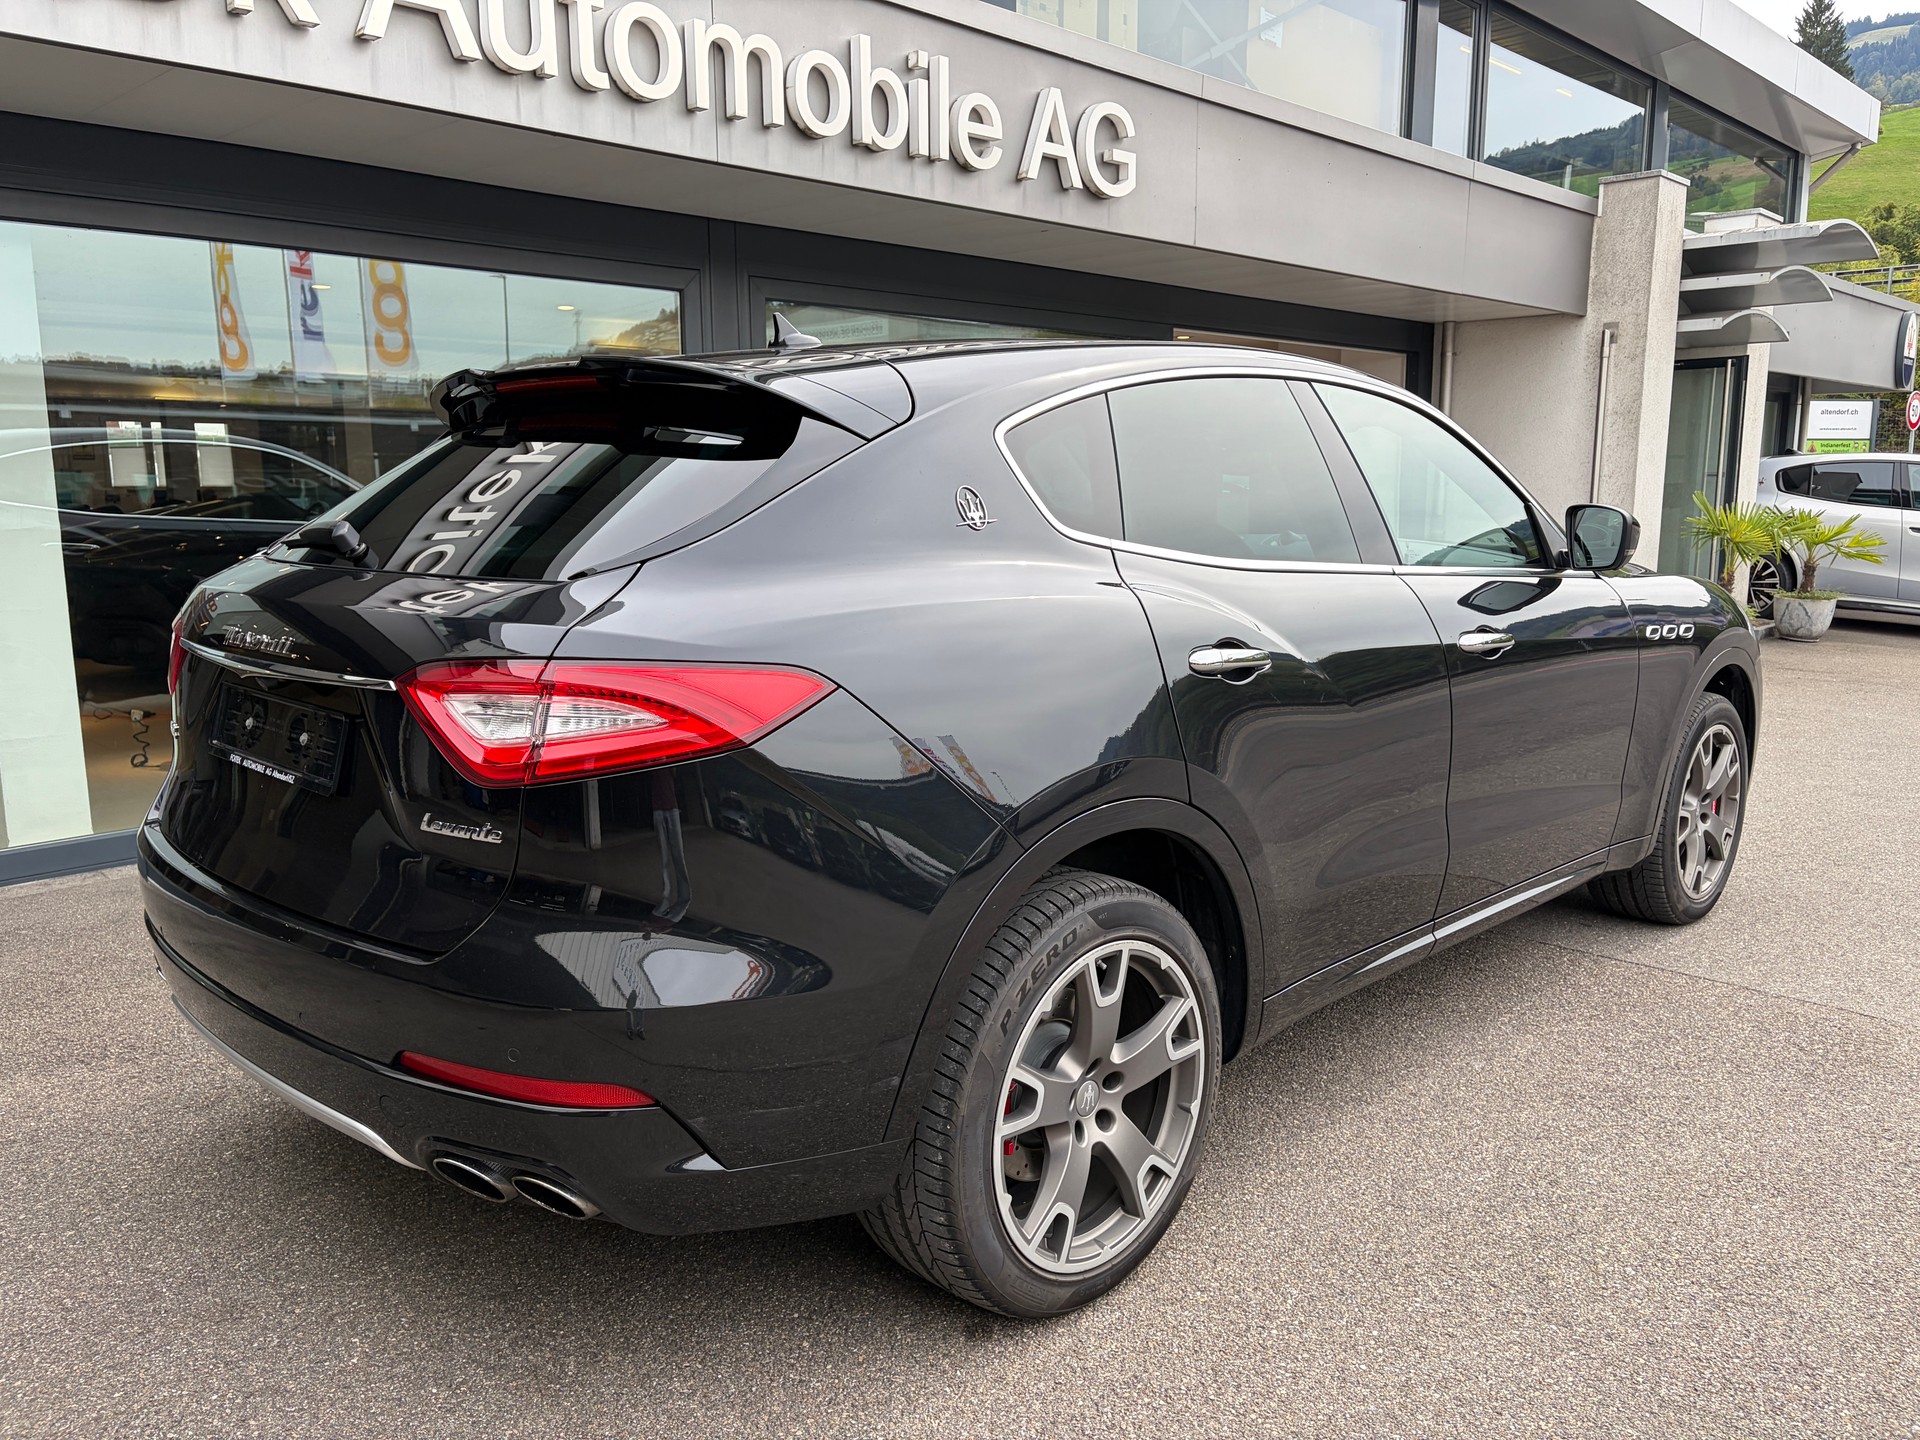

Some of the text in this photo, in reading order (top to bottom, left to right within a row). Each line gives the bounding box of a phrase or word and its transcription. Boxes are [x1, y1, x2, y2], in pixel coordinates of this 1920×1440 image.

[1017, 86, 1137, 199] AG
[368, 260, 411, 366] coo
[1820, 408, 1859, 416] altendorf.ch
[1911, 404, 1919, 418] 50
[242, 758, 265, 774] AUTOMOBILE
[265, 766, 272, 776] AG
[420, 812, 502, 844] Levante
[1000, 927, 1078, 1037] P ZERO
